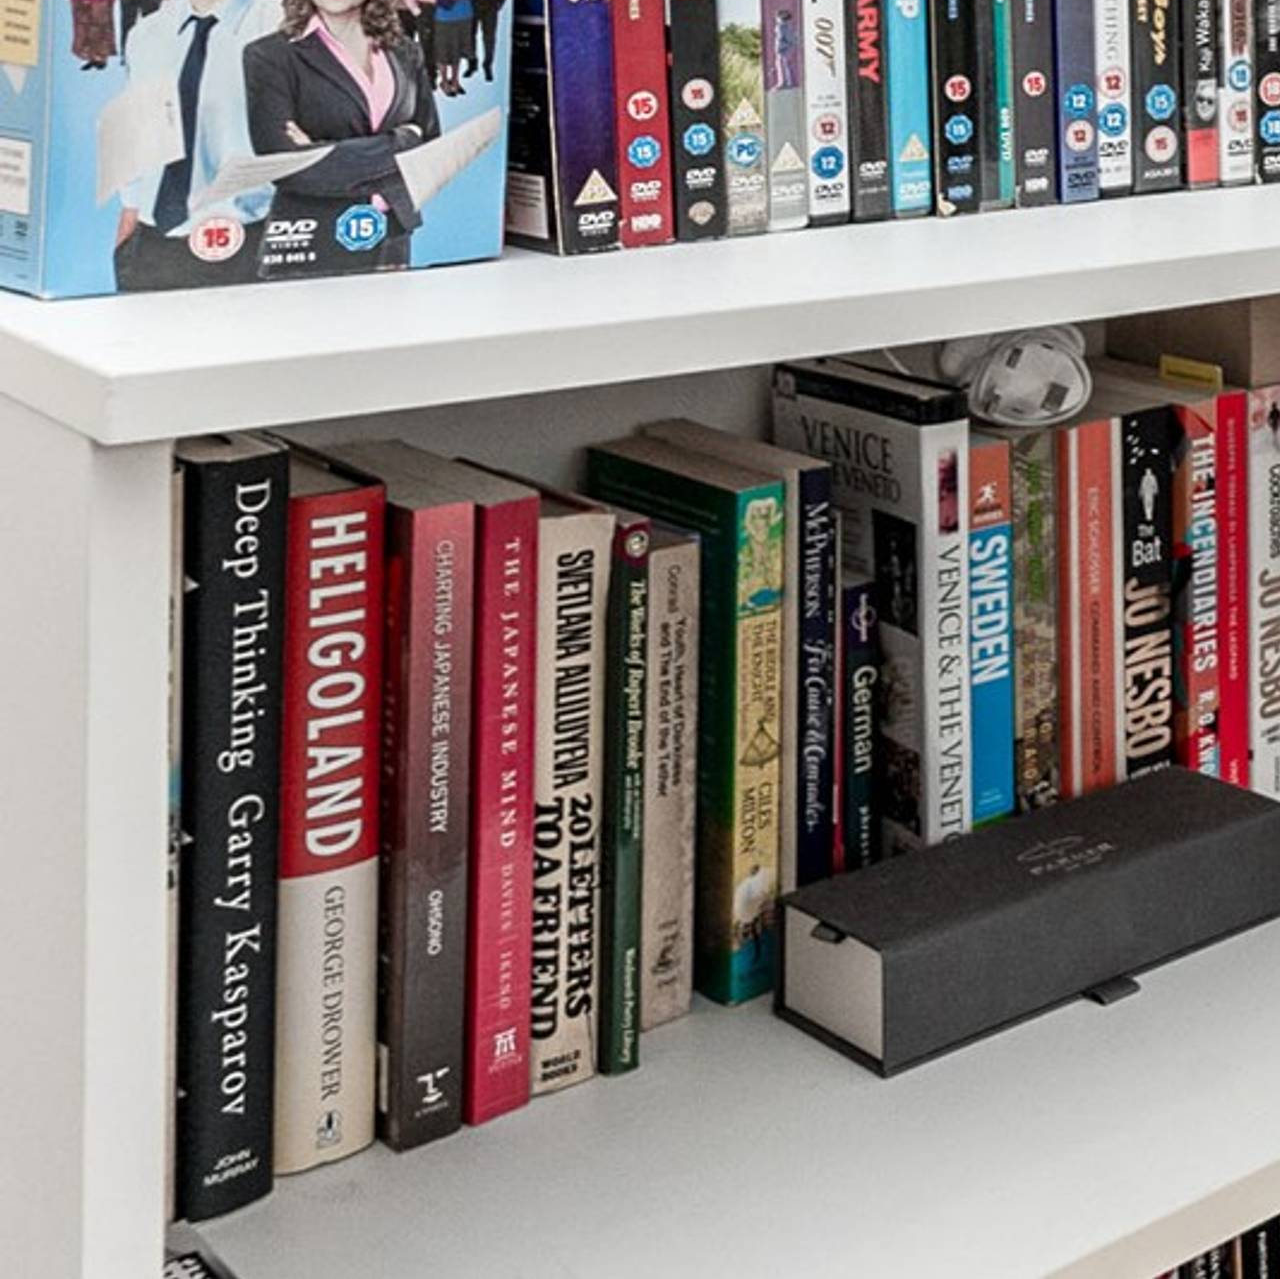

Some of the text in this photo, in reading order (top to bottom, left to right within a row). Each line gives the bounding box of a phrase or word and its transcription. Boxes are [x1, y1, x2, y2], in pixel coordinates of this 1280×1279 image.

[631, 97, 653, 115] 15
[949, 81, 967, 97] 15
[1026, 76, 1042, 92] 15
[203, 228, 230, 248] 15
[266, 220, 318, 235] DVD
[348, 218, 374, 238] 15
[801, 414, 893, 475] VENICE
[501, 536, 522, 597] THE
[1132, 536, 1162, 568] Bat
[1190, 432, 1217, 710] THE INCENDIARIES R.
[629, 578, 645, 607] The
[970, 535, 1010, 686] SWEDEN
[1228, 607, 1238, 626] THE
[624, 650, 644, 666] of
[629, 607, 646, 649] Works
[764, 620, 777, 692] THE RIDDLE
[937, 544, 963, 736] VENICE & THE
[1089, 601, 1102, 673] COMMAND
[1228, 630, 1239, 680] LEOPARD
[500, 610, 522, 756] JAPANESE
[623, 669, 644, 717] Rupert
[666, 564, 688, 786] Conrad Youth, Heart of Darkness
[751, 624, 763, 702] THE KNIGHT
[1090, 678, 1102, 707] AND
[1123, 576, 1172, 758] JO NESBO
[656, 622, 672, 797] and The End the Tether
[853, 664, 878, 773] German
[426, 539, 454, 955] CHARTING JAPANESE INDUSTRY OHSONO
[626, 719, 642, 769] Brooke
[804, 675, 828, 832] Cause Comrades
[211, 479, 270, 1114] Deep Thinking Garry Kasparov
[304, 510, 367, 1101] HELIGOLAND GEORGE DROWER
[499, 769, 520, 848] MIND
[553, 550, 595, 1019] SVETLANA ALLILUYEVA 20 LETTERS
[757, 780, 773, 829] GILES
[741, 786, 758, 854] MILTON
[531, 796, 564, 1040] TO A FRIEND
[500, 950, 514, 1010] IKENO
[621, 1031, 634, 1064] Library
[203, 1158, 260, 1188] MURRAY
[213, 1148, 251, 1172] JOHN
